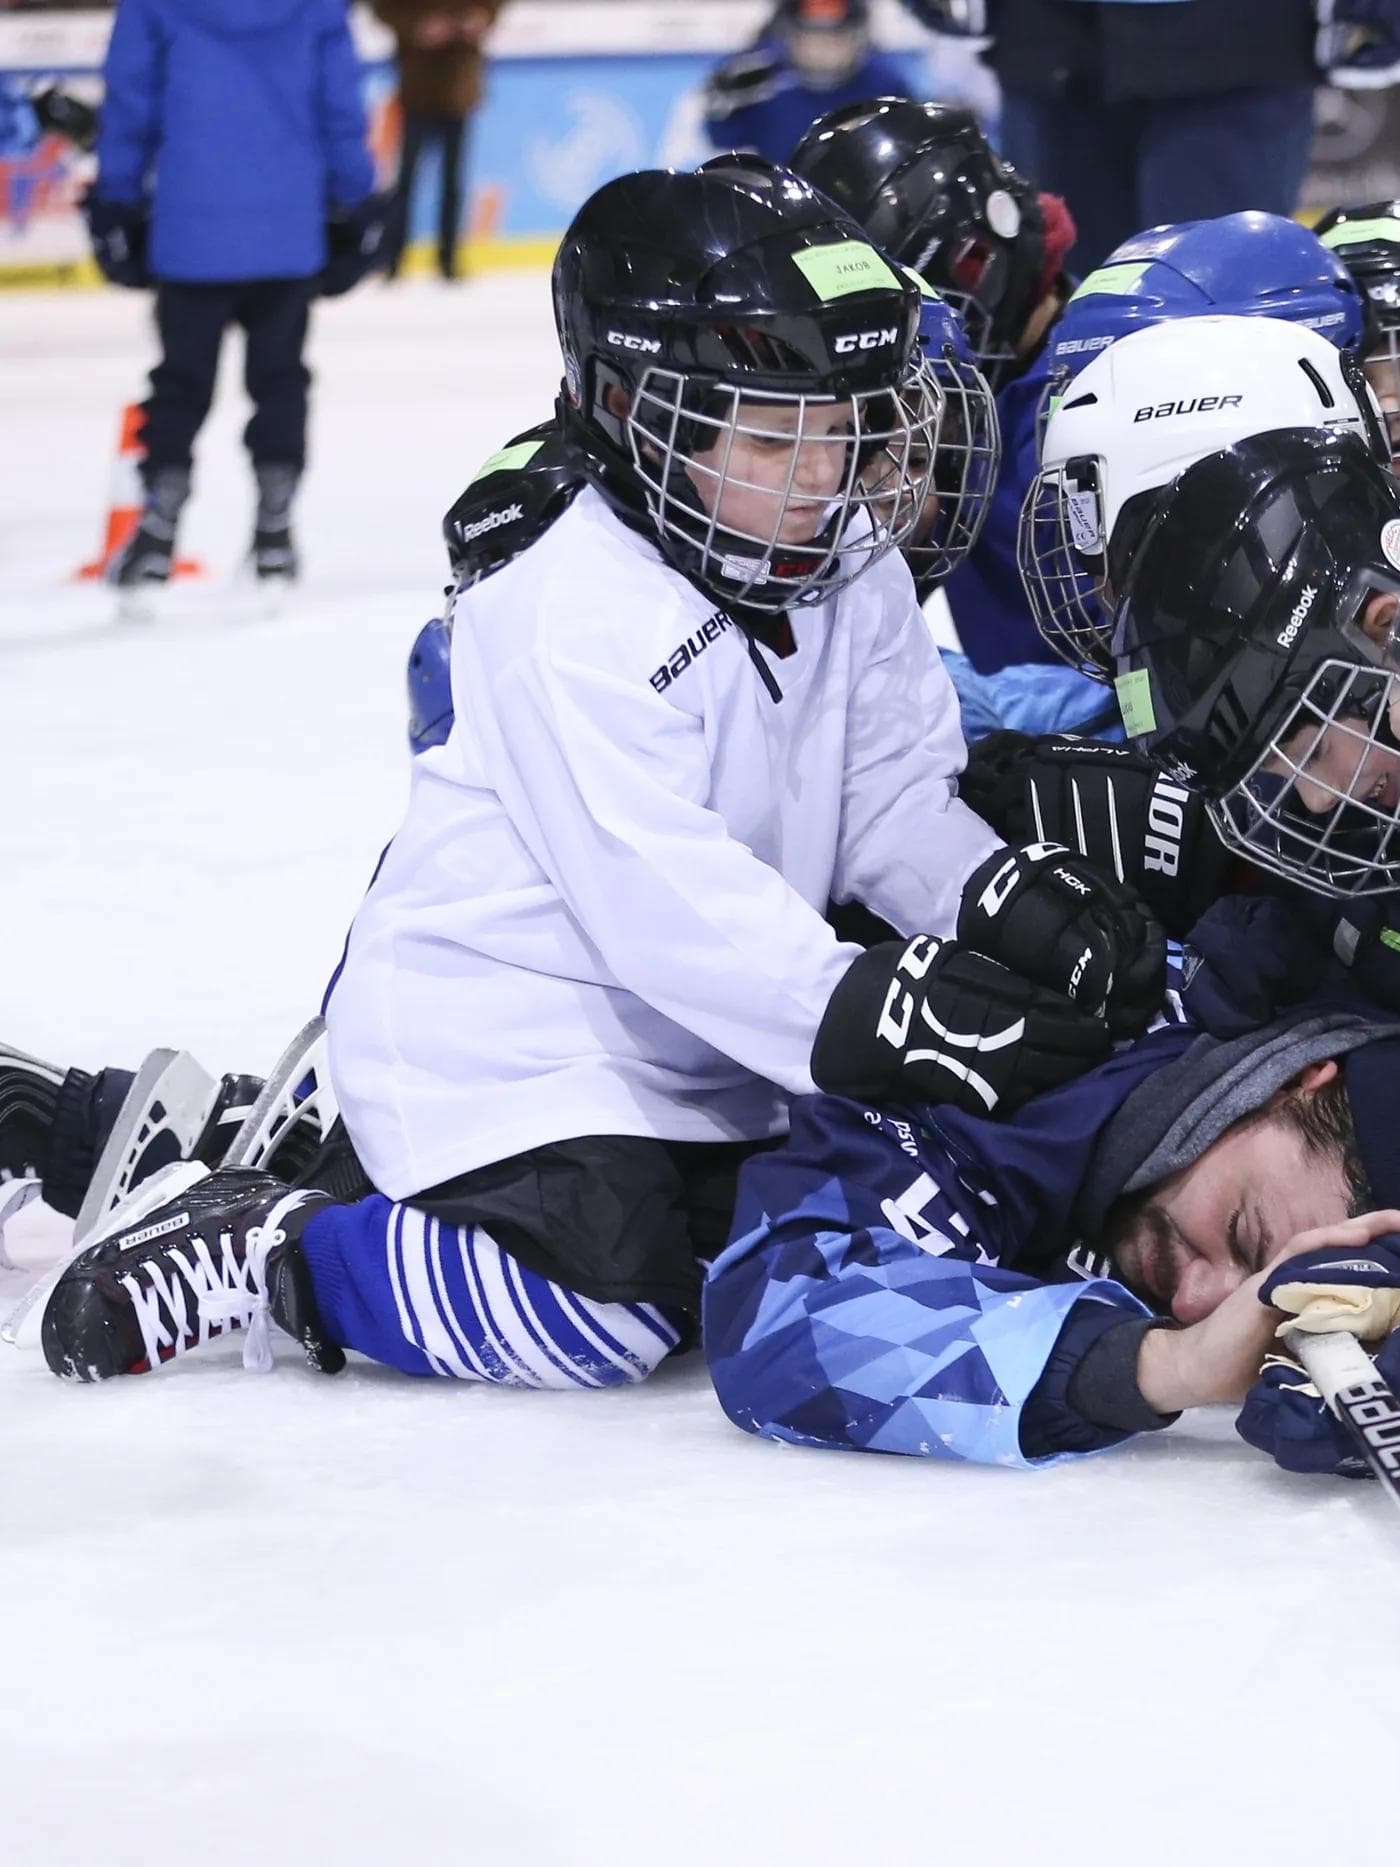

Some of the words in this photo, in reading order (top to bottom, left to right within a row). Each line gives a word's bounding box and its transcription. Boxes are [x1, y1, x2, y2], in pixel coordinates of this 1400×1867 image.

[835, 261, 871, 274] JAKOB
[607, 330, 662, 354] CCM
[834, 326, 898, 354] CCM
[1055, 335, 1115, 356] BAUER
[1133, 395, 1243, 424] BAUER
[463, 503, 524, 543] Reebok
[1277, 584, 1318, 649] Reebok
[649, 610, 733, 694] BAUER
